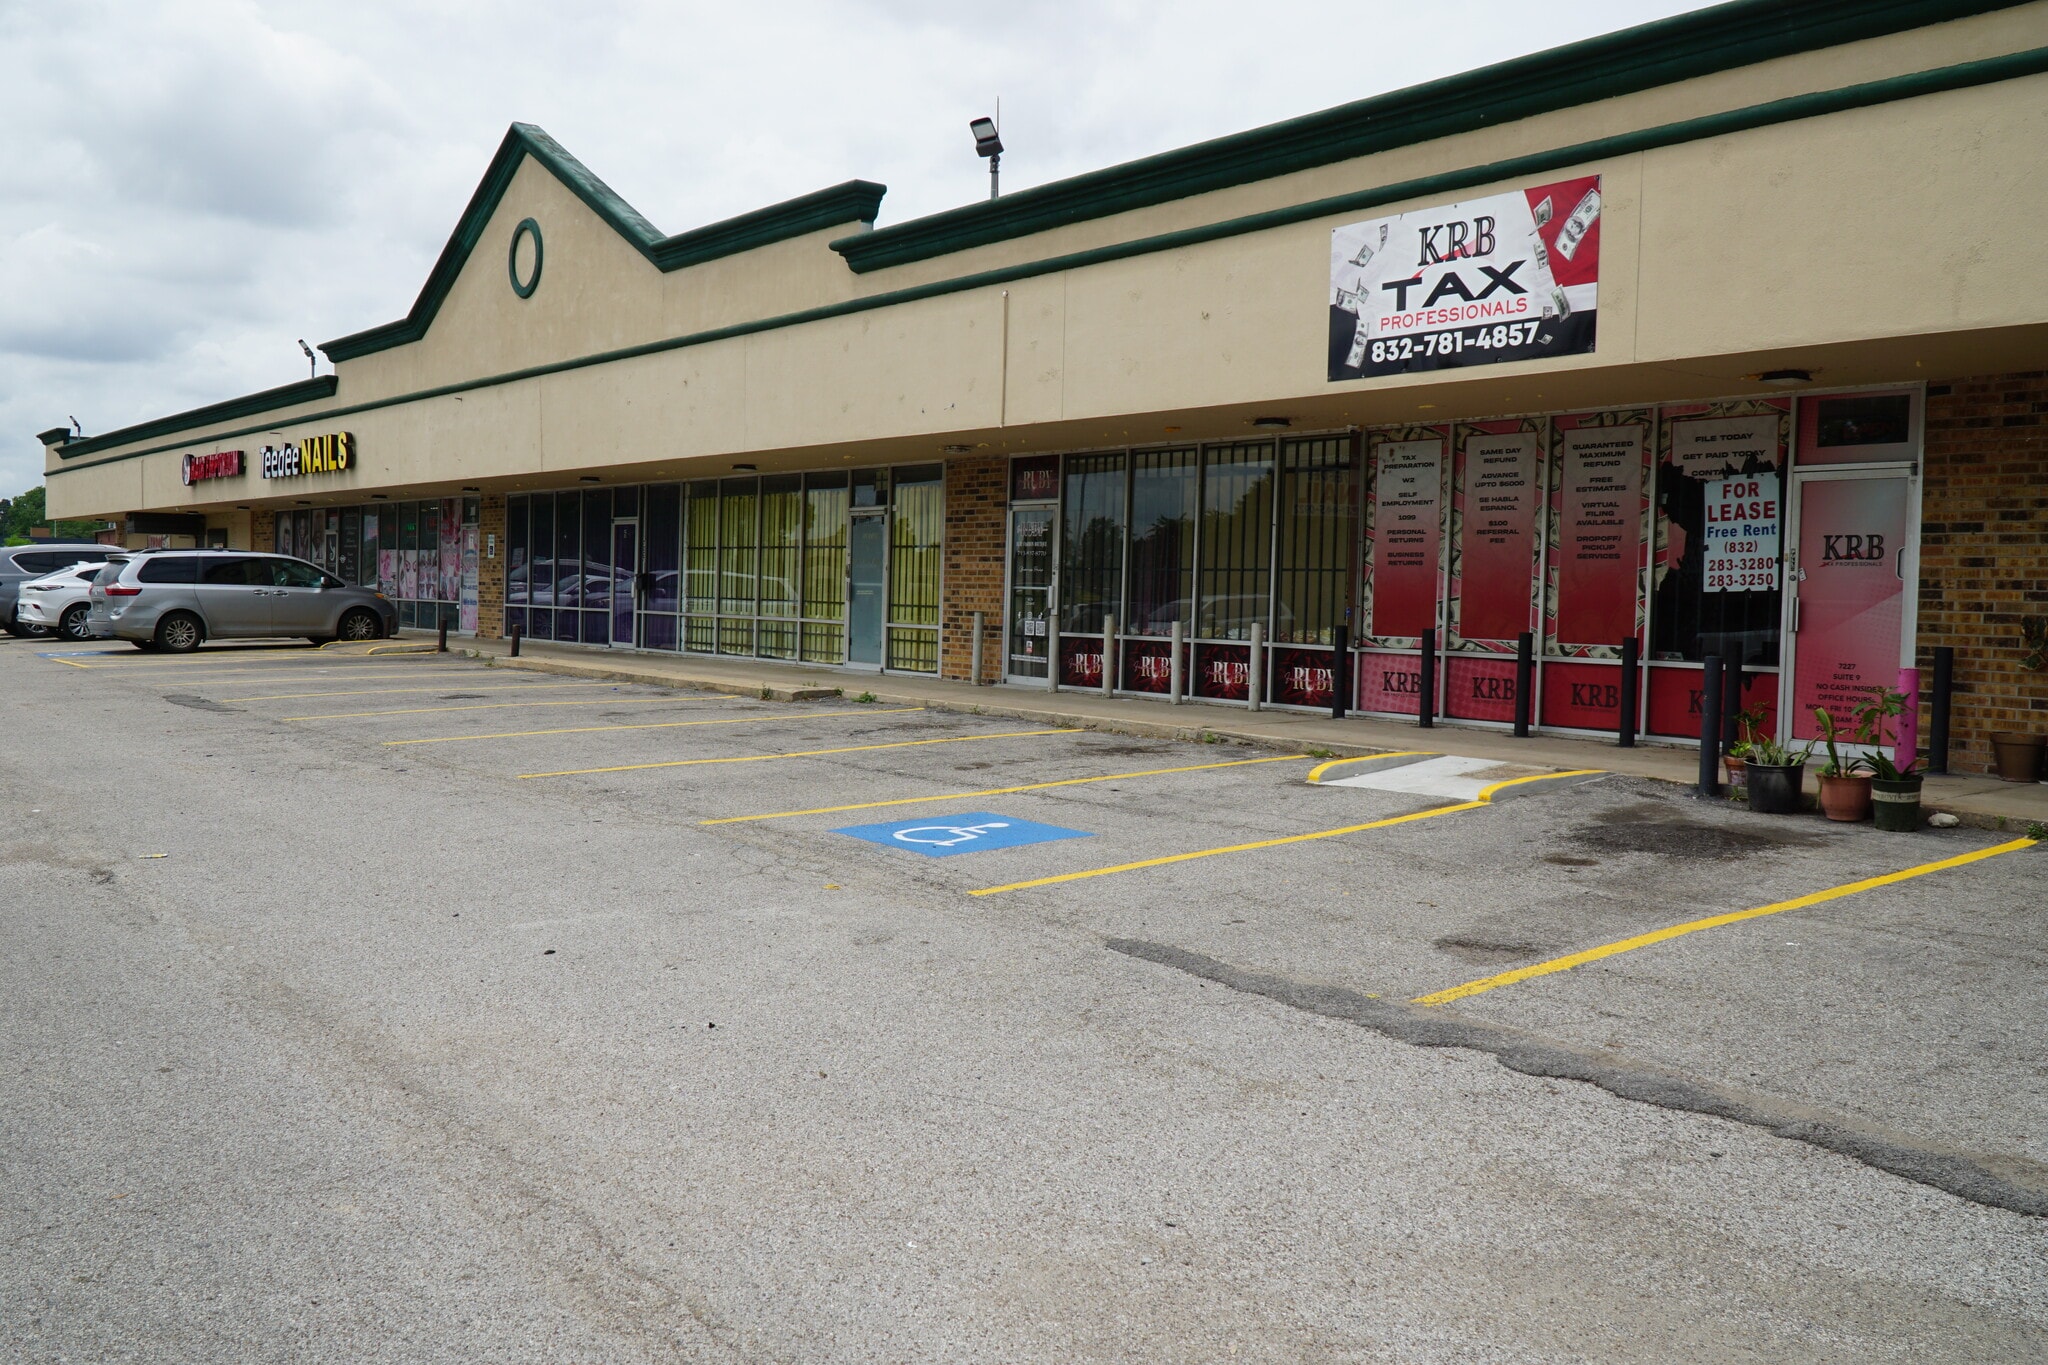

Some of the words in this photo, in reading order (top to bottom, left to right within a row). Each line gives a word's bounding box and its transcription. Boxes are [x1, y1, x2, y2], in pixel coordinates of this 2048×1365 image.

[1418, 216, 1496, 267] KRB
[1382, 259, 1529, 312] TAX
[1380, 297, 1528, 331] PROFESSIONALS
[1371, 321, 1540, 363] 832-781-4857
[1572, 441, 1634, 450] GUARANTEED
[1720, 433, 1754, 441] TODAY
[260, 443, 299, 479] Teedee
[301, 431, 348, 474] NAILS
[1480, 448, 1503, 456] SAME
[1483, 456, 1517, 464] REFUND
[1579, 450, 1626, 459] MAXIMUM
[1706, 451, 1729, 459] PAID
[1732, 450, 1766, 458] TODAY
[1384, 462, 1435, 470] PREPARATION
[1583, 460, 1621, 468] REFUND
[1022, 470, 1053, 490] RUBY
[1723, 481, 1759, 499] FOR
[1381, 499, 1434, 507] EMPLOYMENT
[1708, 501, 1776, 522] LEASE
[1707, 526, 1737, 538] Free
[1744, 523, 1776, 536] Rent
[1724, 540, 1758, 554] (832)
[1822, 534, 1885, 561] KRB
[1708, 557, 1774, 572] 283-3280
[1708, 573, 1774, 587] 283-3250
[1140, 656, 1171, 678] RUB
[1293, 666, 1335, 692] RUBY
[1382, 671, 1421, 693] KRB
[1472, 677, 1515, 700] KRB
[1571, 683, 1618, 708] KRB
